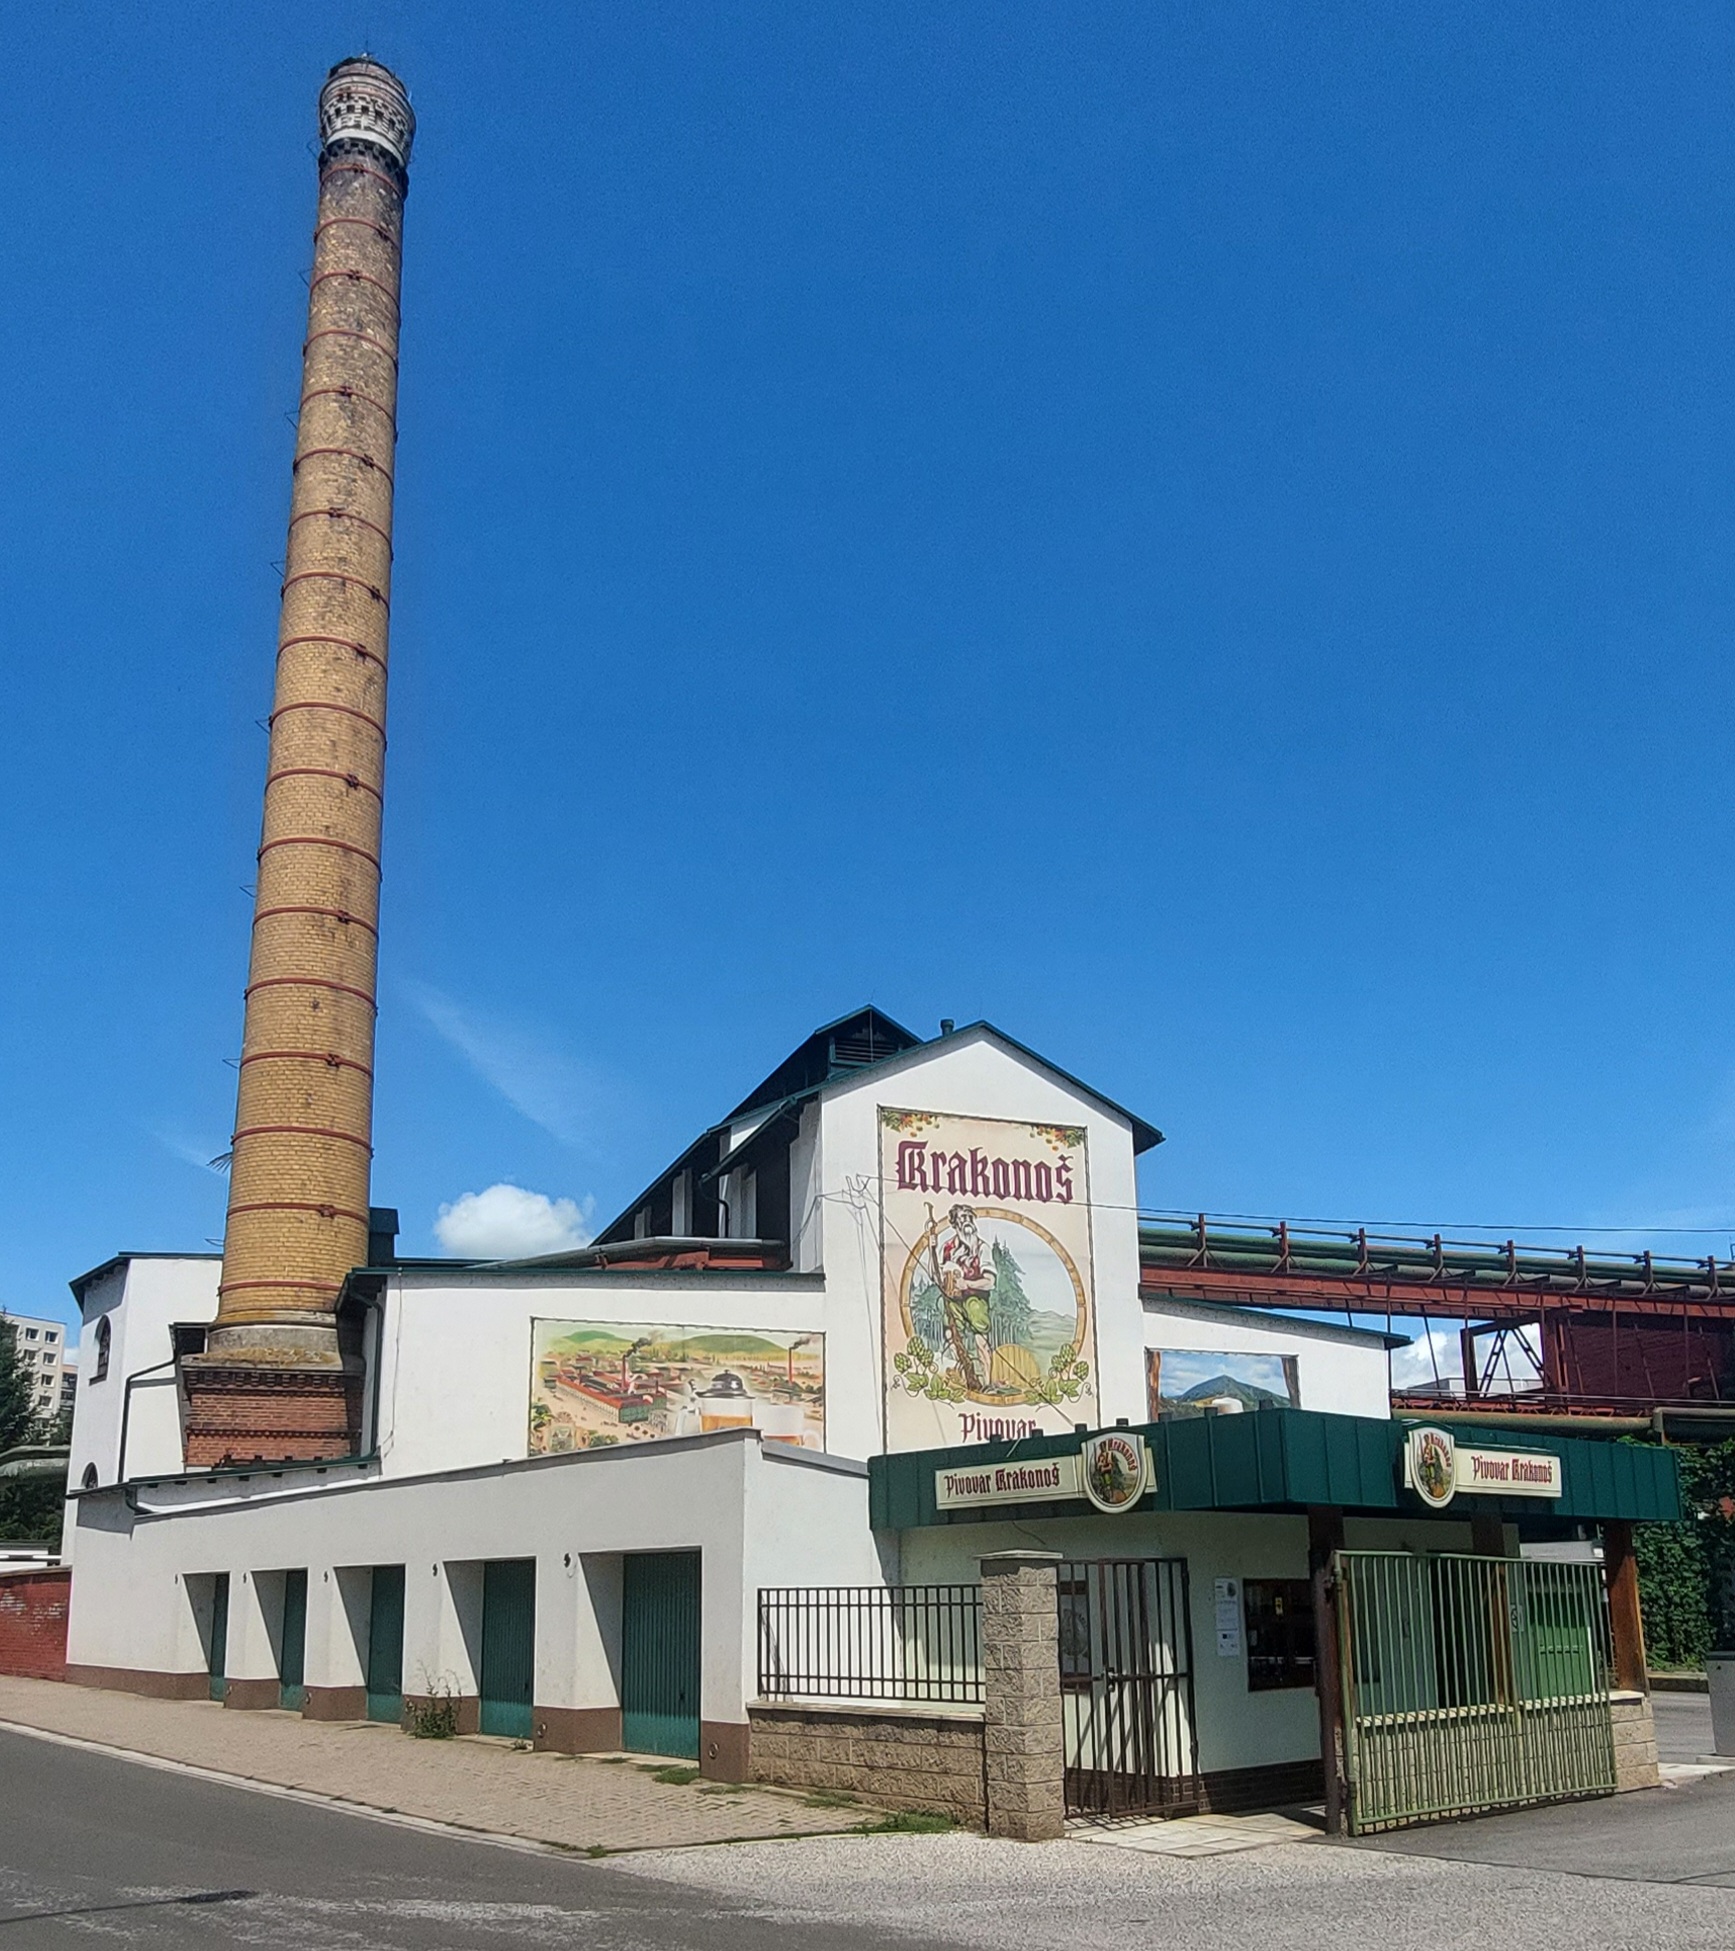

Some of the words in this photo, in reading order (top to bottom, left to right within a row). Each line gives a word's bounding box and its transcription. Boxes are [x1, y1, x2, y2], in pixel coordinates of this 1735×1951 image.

[895, 1140, 1074, 1204] Krakonoš
[957, 1411, 1037, 1443] Pivovar
[943, 1473, 992, 1498] Pivovar
[995, 1462, 1060, 1492] Krakonoš
[1471, 1455, 1510, 1480] Pivovar
[1512, 1458, 1553, 1484] Krakonoš
